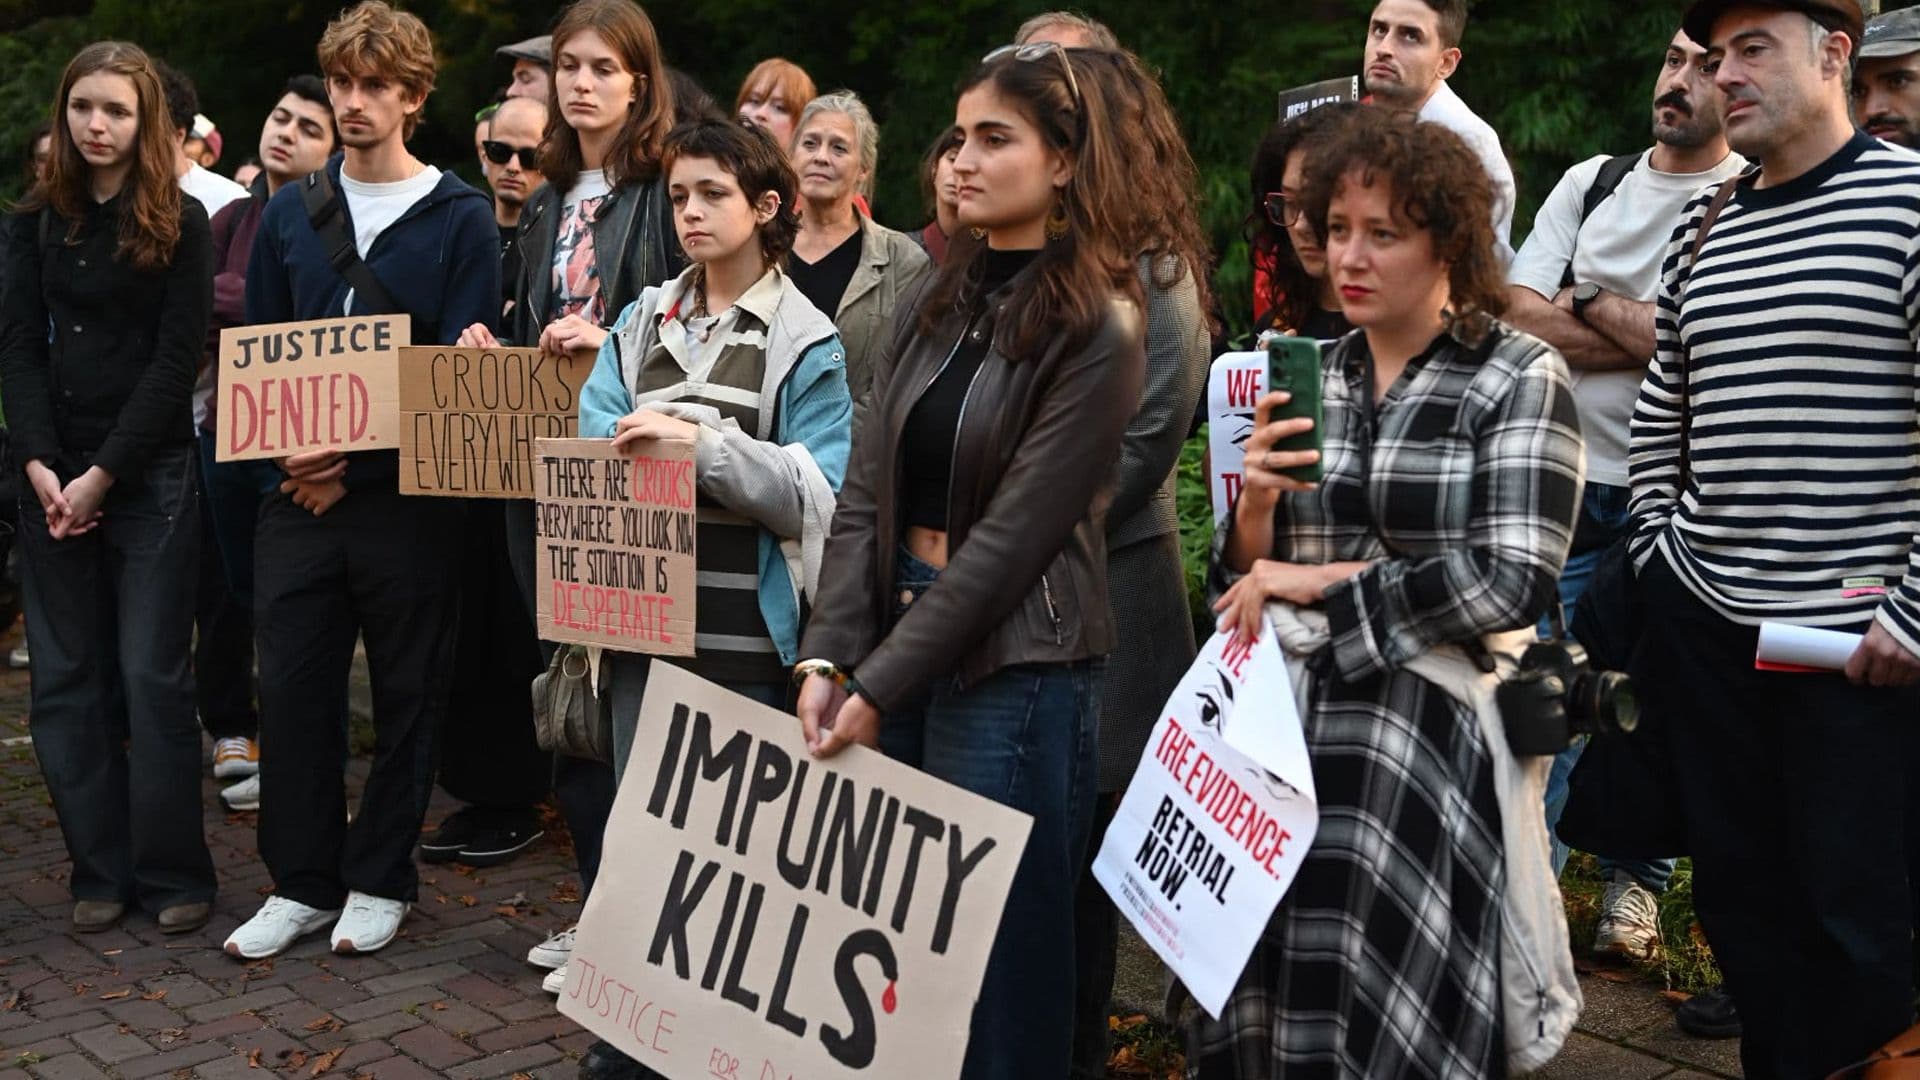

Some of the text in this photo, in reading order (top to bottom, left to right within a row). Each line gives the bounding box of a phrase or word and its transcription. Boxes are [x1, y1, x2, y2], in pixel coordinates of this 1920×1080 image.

[233, 321, 391, 369] JUSTICE
[431, 353, 573, 411] CROOKS
[231, 373, 377, 455] DENIED.
[1227, 369, 1262, 407] WE
[415, 412, 579, 491] EVERYWH
[543, 456, 694, 509] THERE ARE CROOKS
[536, 501, 615, 544] EVERYWHERE
[621, 507, 643, 548] YOU
[646, 510, 674, 551] LOOK
[547, 545, 668, 594] THE SITUATION IS
[553, 581, 674, 644] DESPERATE
[646, 702, 997, 955] IMPUNITY
[1154, 717, 1293, 881] THE EVIDENCE.
[1134, 830, 1191, 912] NOW.
[1152, 793, 1237, 906] RETRIAL
[646, 849, 899, 1071] KILLS
[569, 958, 678, 1055] JUSTICE
[708, 1047, 740, 1080] FOR
